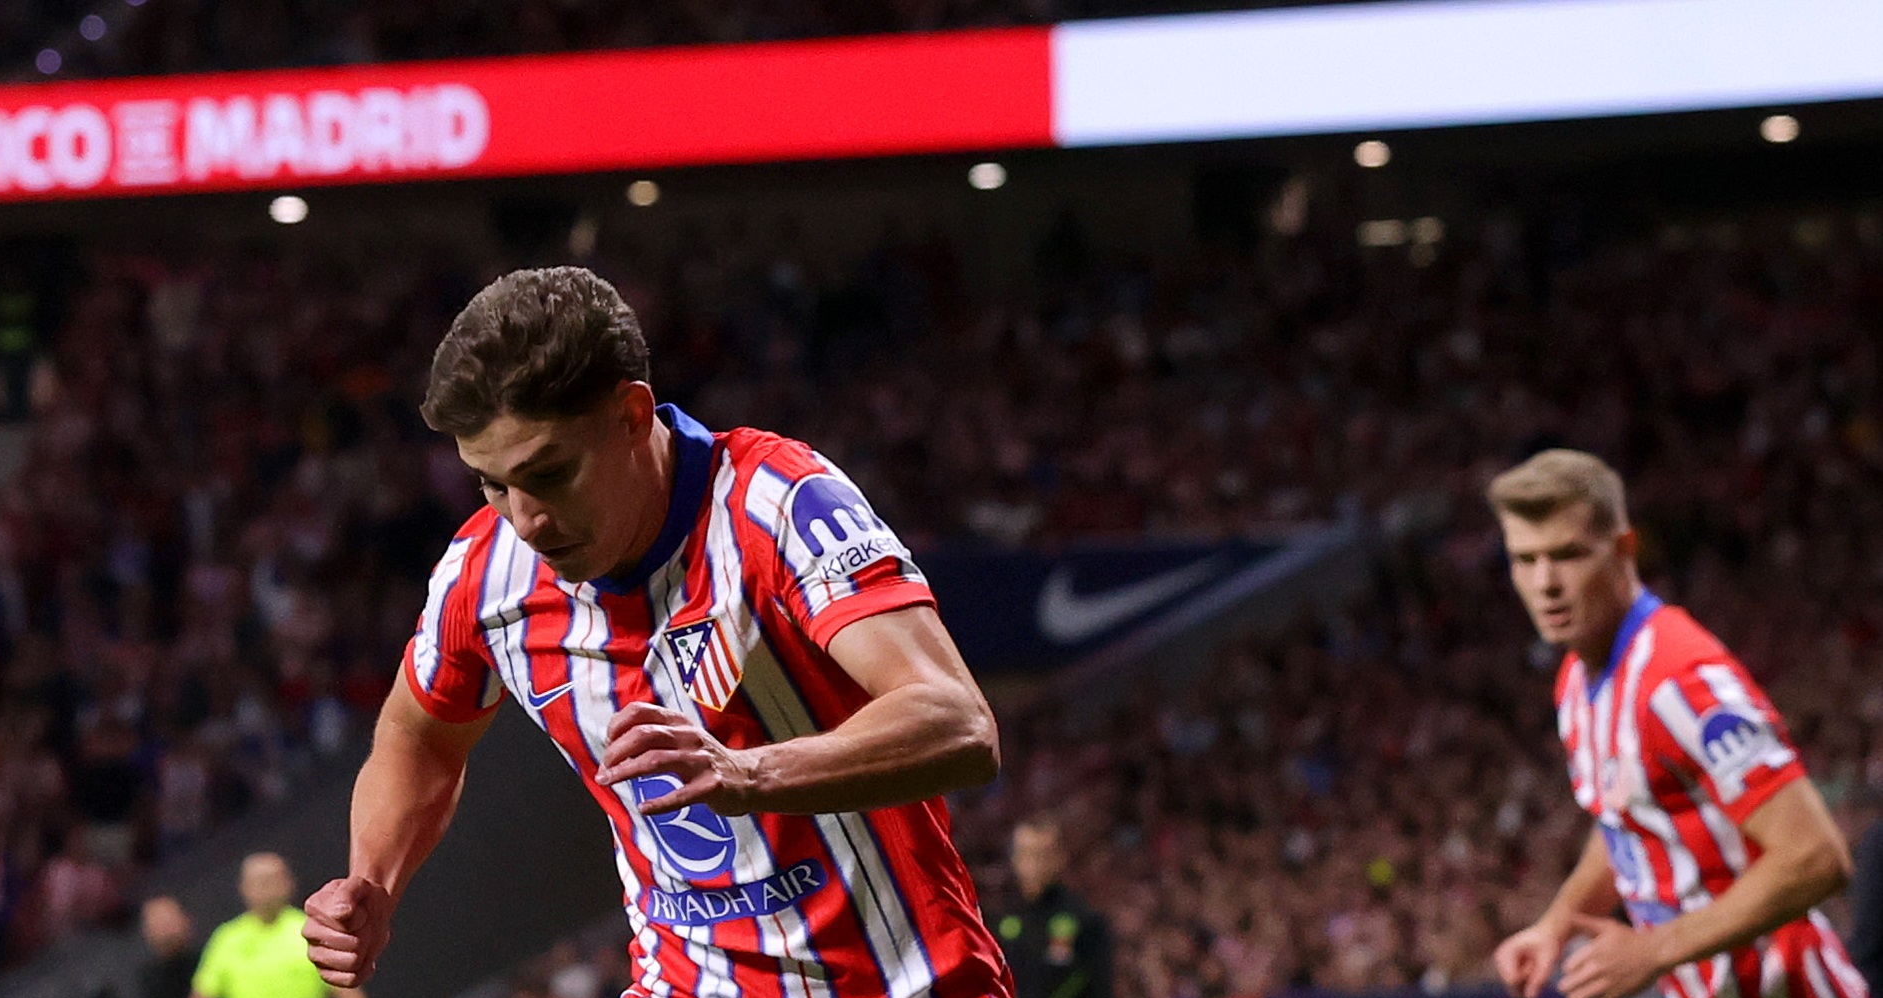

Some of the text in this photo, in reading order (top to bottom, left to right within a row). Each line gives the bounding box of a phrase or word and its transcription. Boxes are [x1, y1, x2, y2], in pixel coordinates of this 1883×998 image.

[184, 84, 489, 181] MADRID
[652, 864, 821, 922] RIYADH AIR
